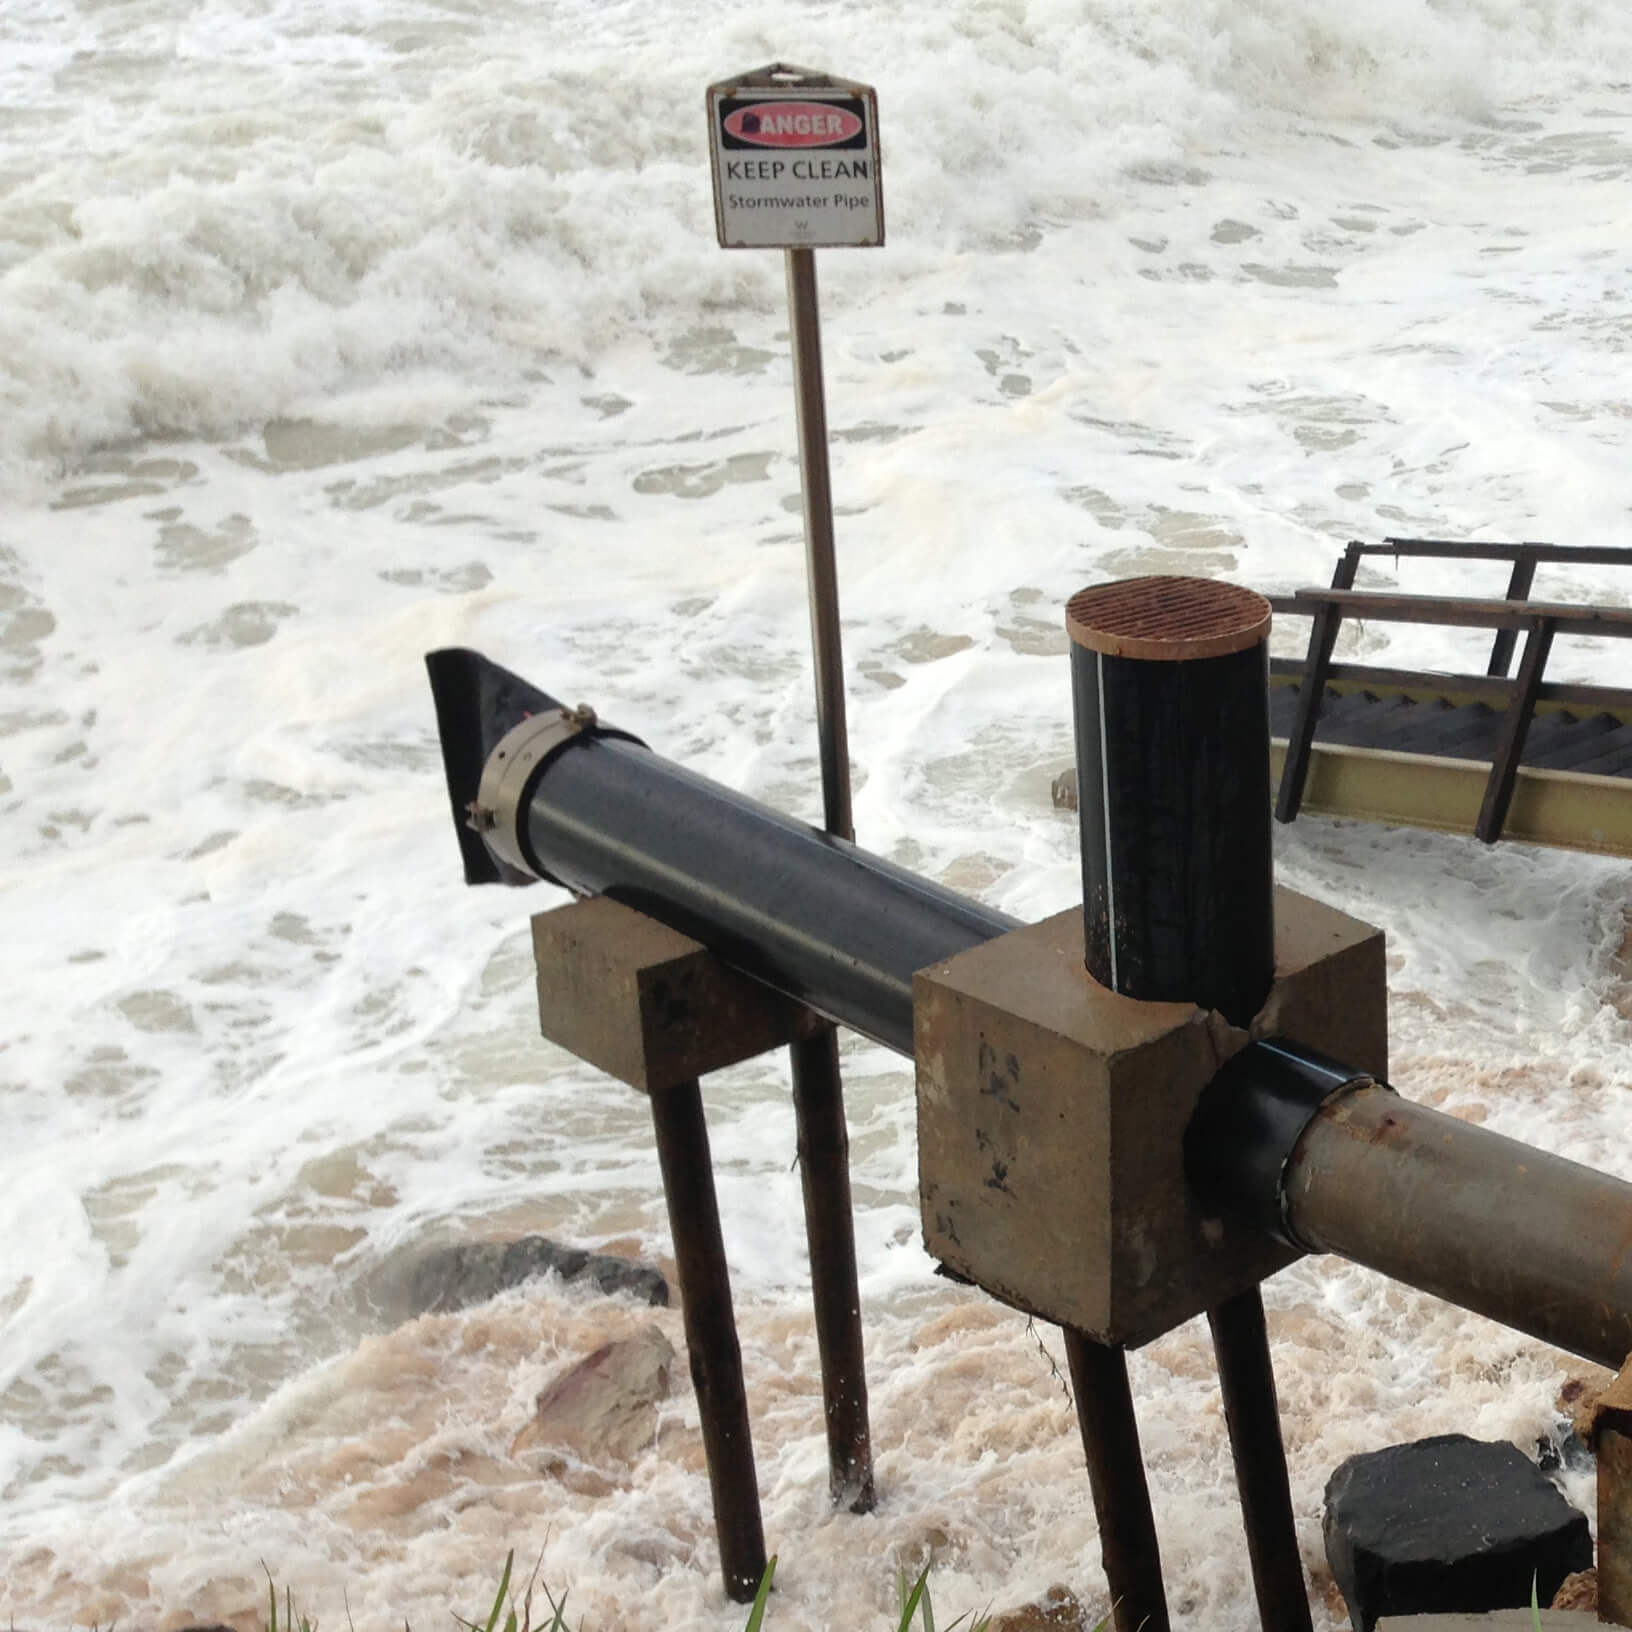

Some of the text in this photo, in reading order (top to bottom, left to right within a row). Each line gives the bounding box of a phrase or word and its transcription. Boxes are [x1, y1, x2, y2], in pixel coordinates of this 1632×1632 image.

[727, 160, 785, 180] KEEP
[729, 193, 869, 211] Stormwater Pipe
